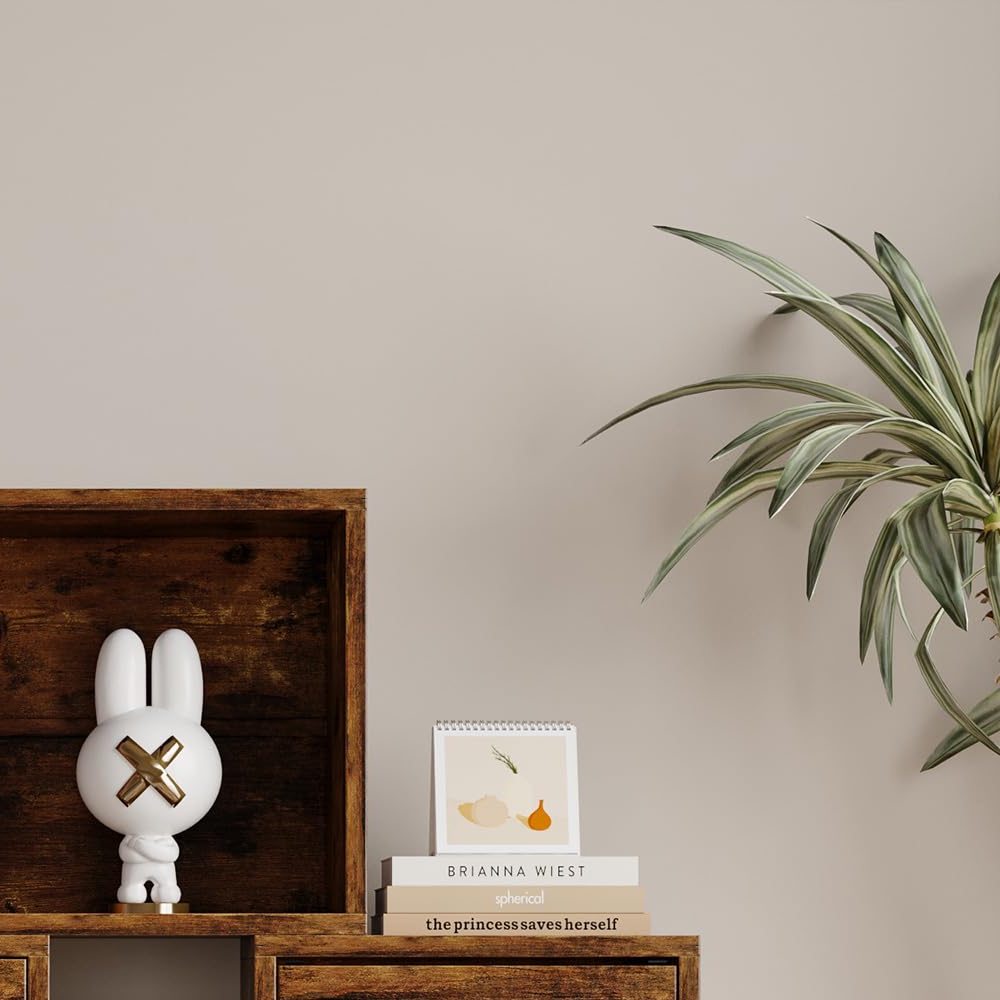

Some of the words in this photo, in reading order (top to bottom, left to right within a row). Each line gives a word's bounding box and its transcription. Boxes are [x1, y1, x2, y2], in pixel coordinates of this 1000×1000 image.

[448, 865, 526, 877] BRIANNA
[536, 865, 586, 877] WIEST
[495, 889, 544, 909] spherical
[426, 917, 451, 931] the
[454, 919, 519, 935] princess
[520, 921, 562, 931] saves
[564, 917, 619, 931] herself
